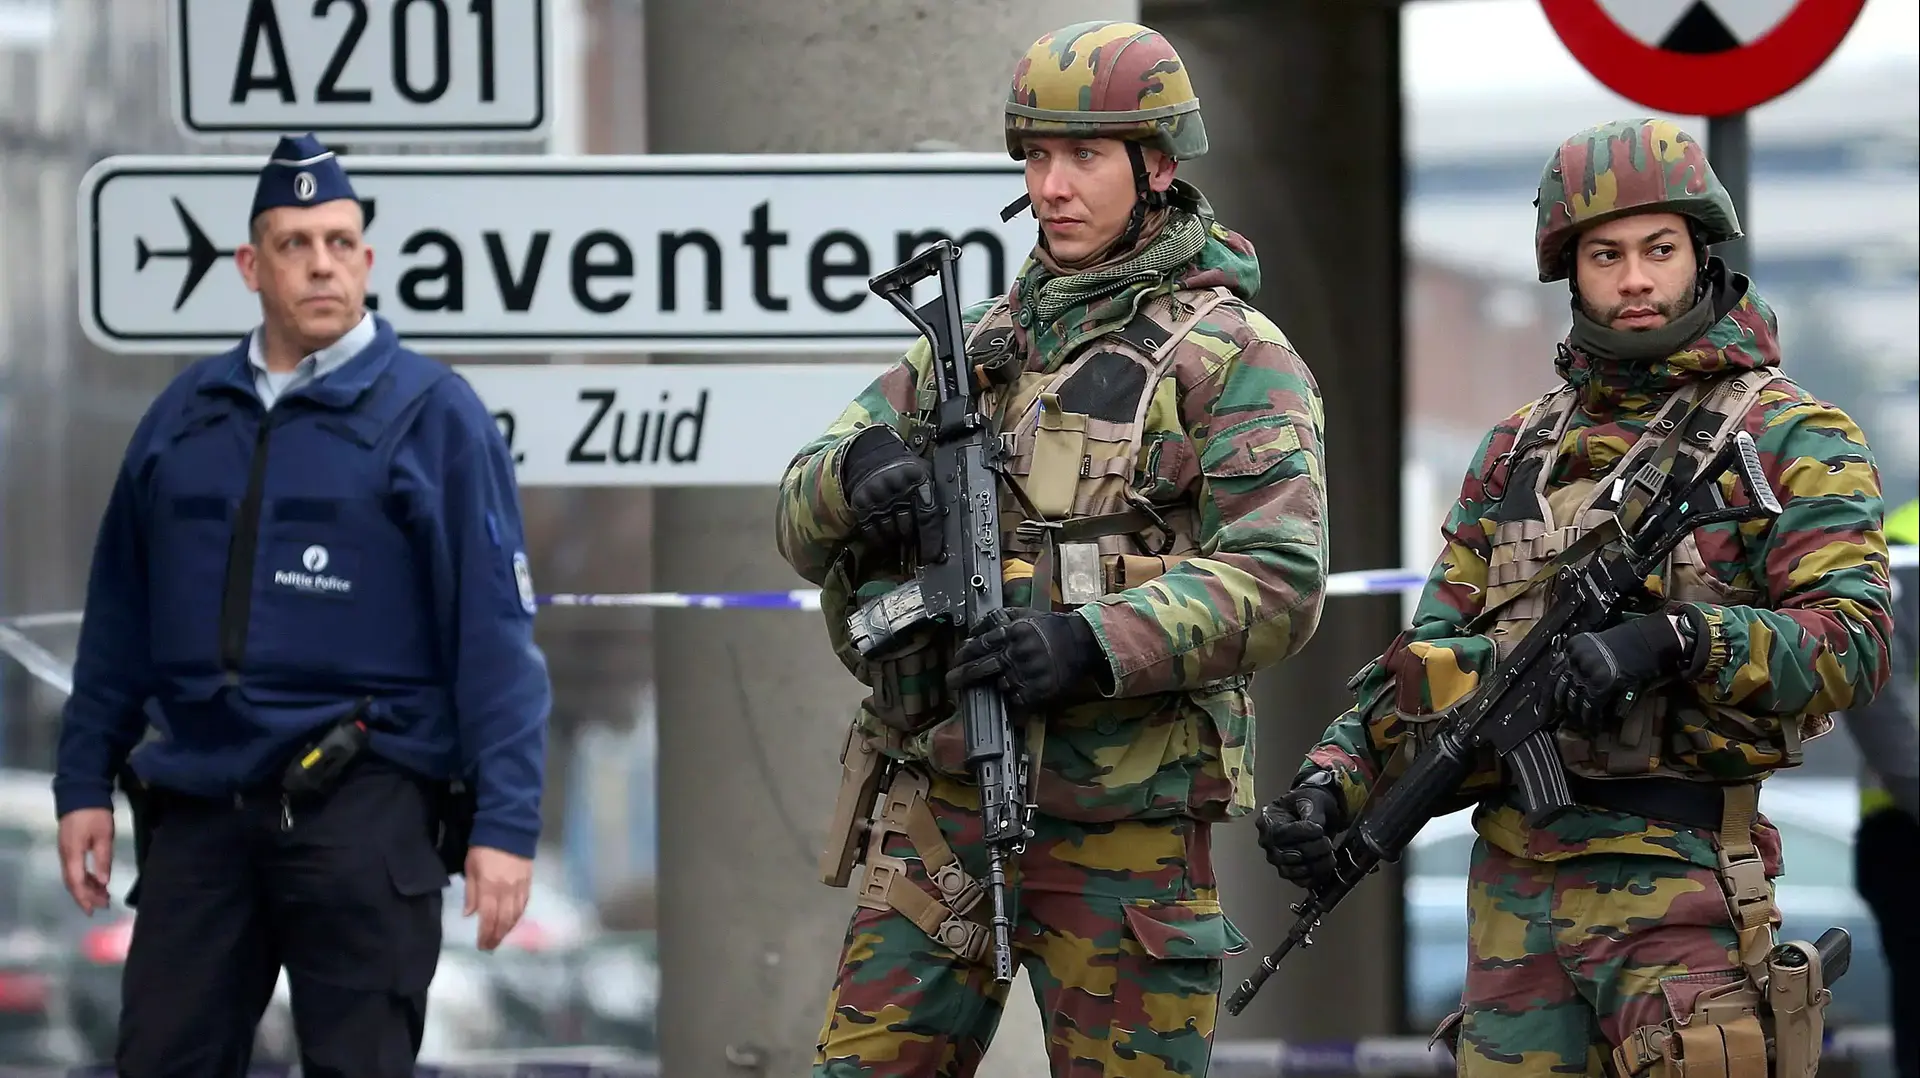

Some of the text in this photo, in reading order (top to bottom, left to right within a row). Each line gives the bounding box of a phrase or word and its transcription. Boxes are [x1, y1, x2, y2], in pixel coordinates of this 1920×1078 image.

[230, 0, 496, 103] A201
[361, 199, 1005, 312] aventem
[566, 388, 710, 464] Zuid
[274, 570, 352, 592] Politie Police
